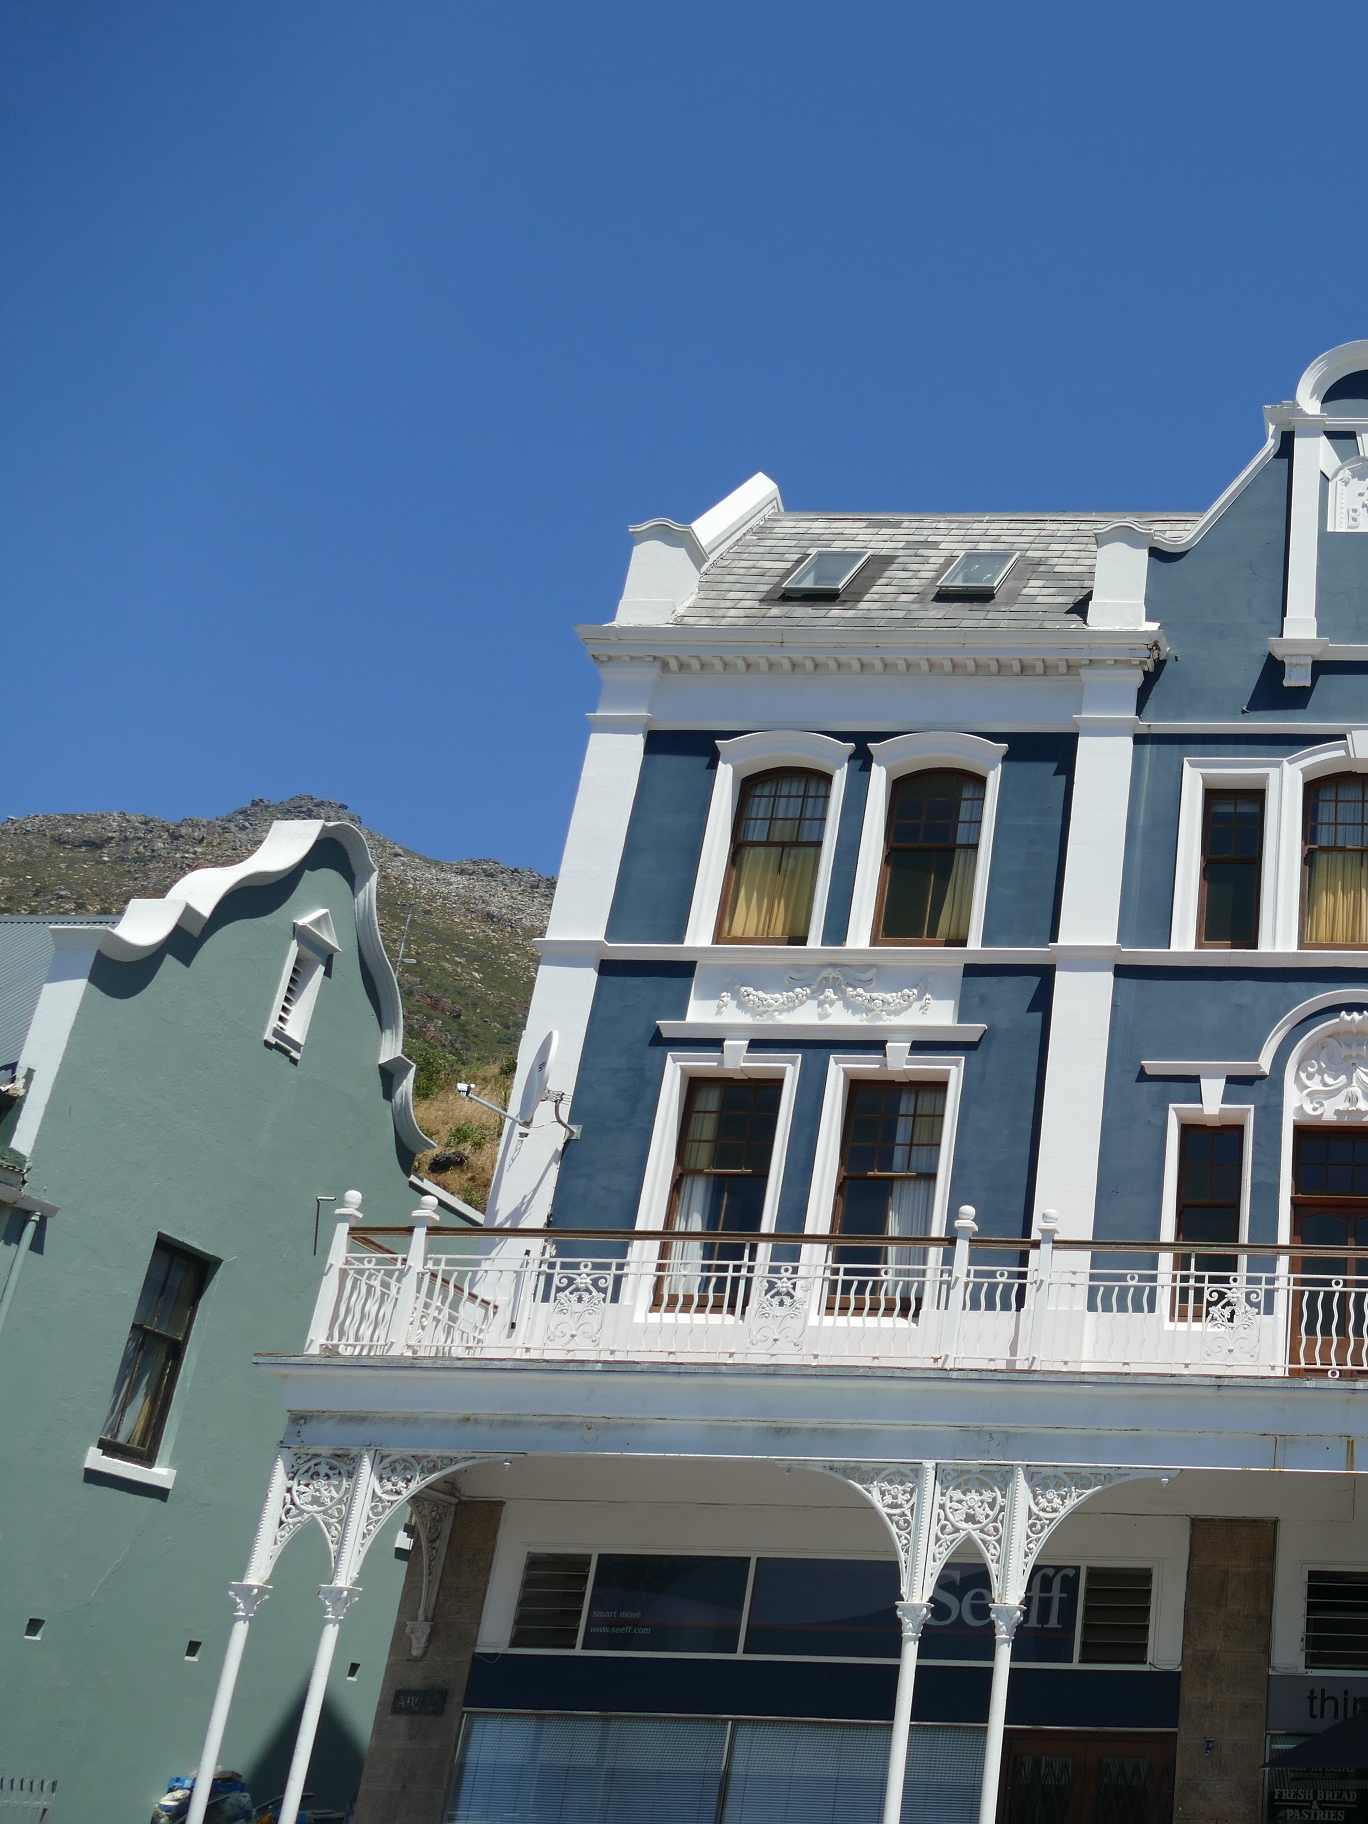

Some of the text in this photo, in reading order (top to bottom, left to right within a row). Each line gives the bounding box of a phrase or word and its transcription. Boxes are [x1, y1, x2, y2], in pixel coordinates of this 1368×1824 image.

[1347, 508, 1362, 529] B
[926, 1567, 1076, 1628] Seff
[593, 1610, 642, 1619] smart move
[590, 1625, 651, 1634] www.seeff.com
[1274, 1788, 1358, 1802] FRESH BREAD
[1311, 1800, 1321, 1810] &
[1286, 1809, 1346, 1821] PASTRIES
